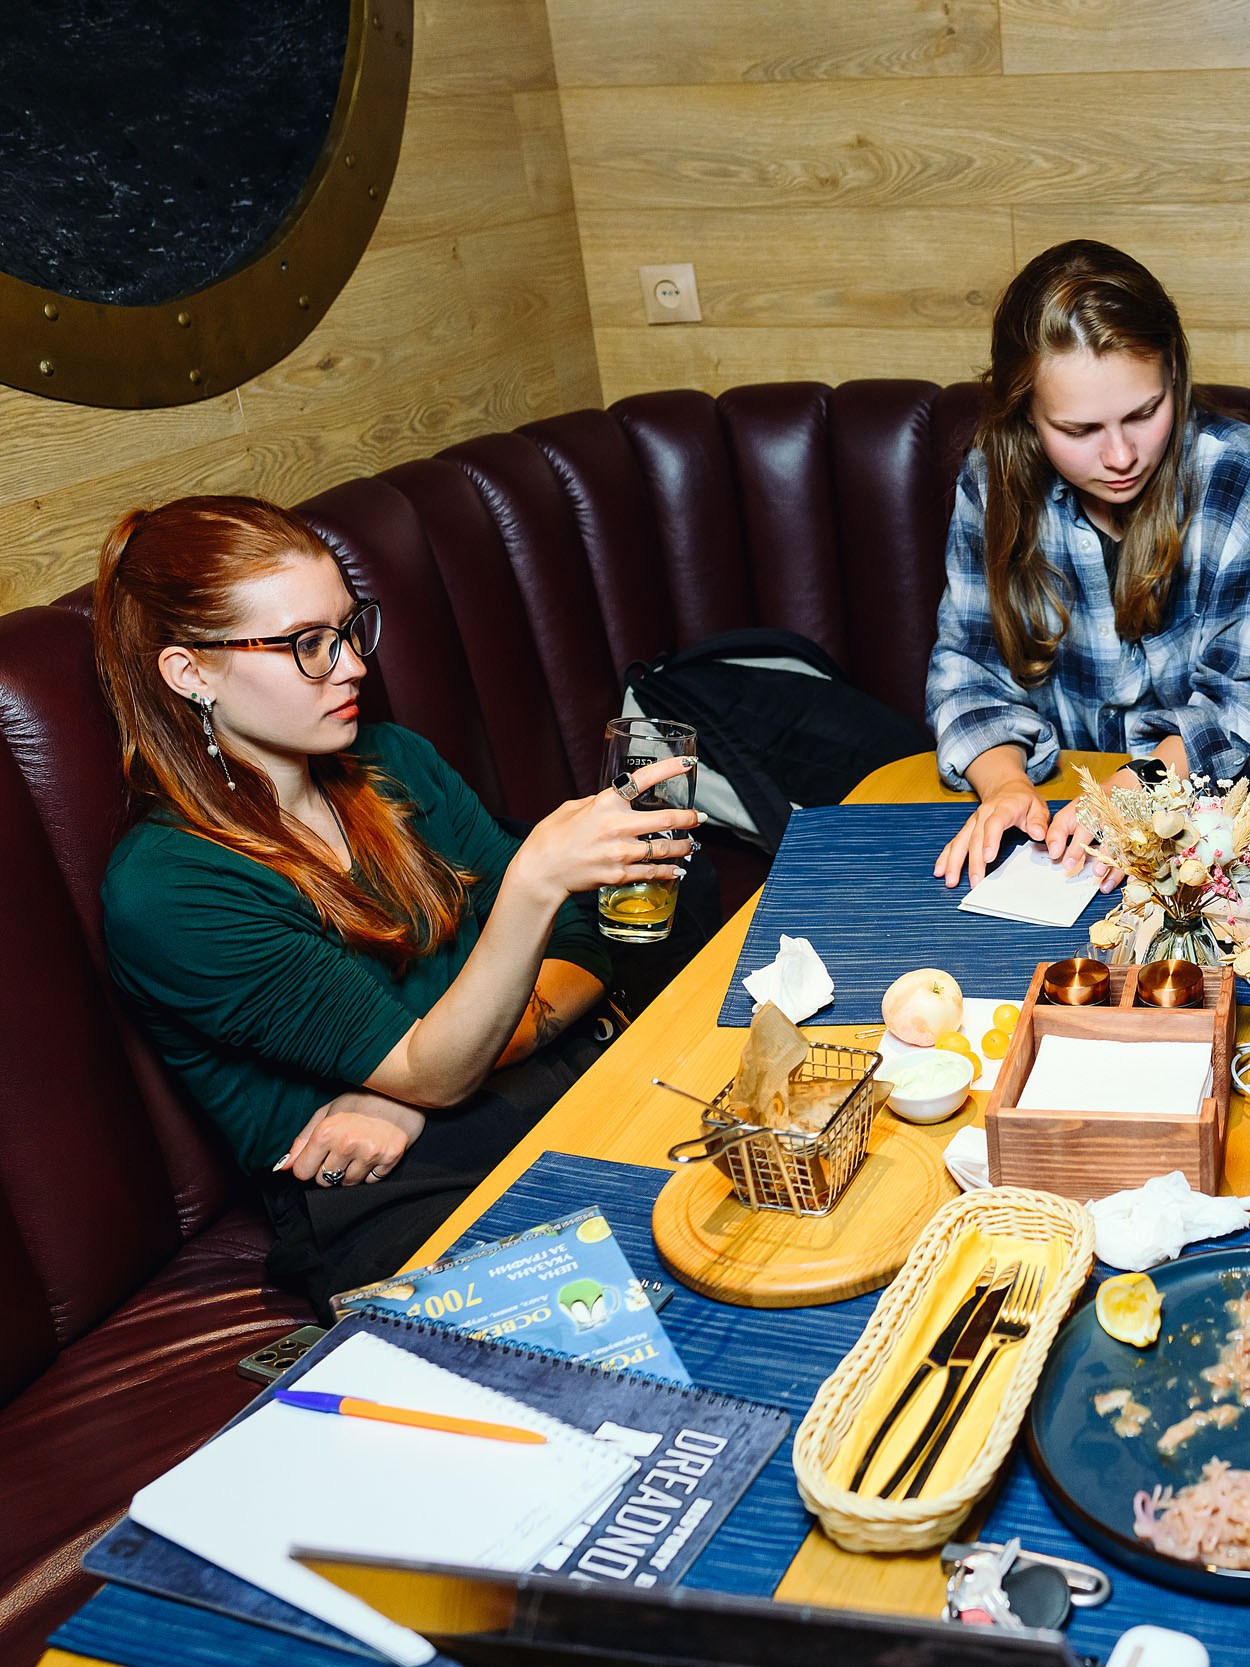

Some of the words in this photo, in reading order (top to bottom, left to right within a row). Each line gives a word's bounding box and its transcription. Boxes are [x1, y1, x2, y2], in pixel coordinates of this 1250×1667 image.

[547, 1242, 567, 1255] ЗА
[487, 1249, 549, 1278] ГРАФИН
[506, 1252, 573, 1281] УКАЗАНА
[536, 1260, 579, 1281] ЦЕНА
[425, 1282, 482, 1320] 700
[567, 1429, 728, 1585] DREADNO
